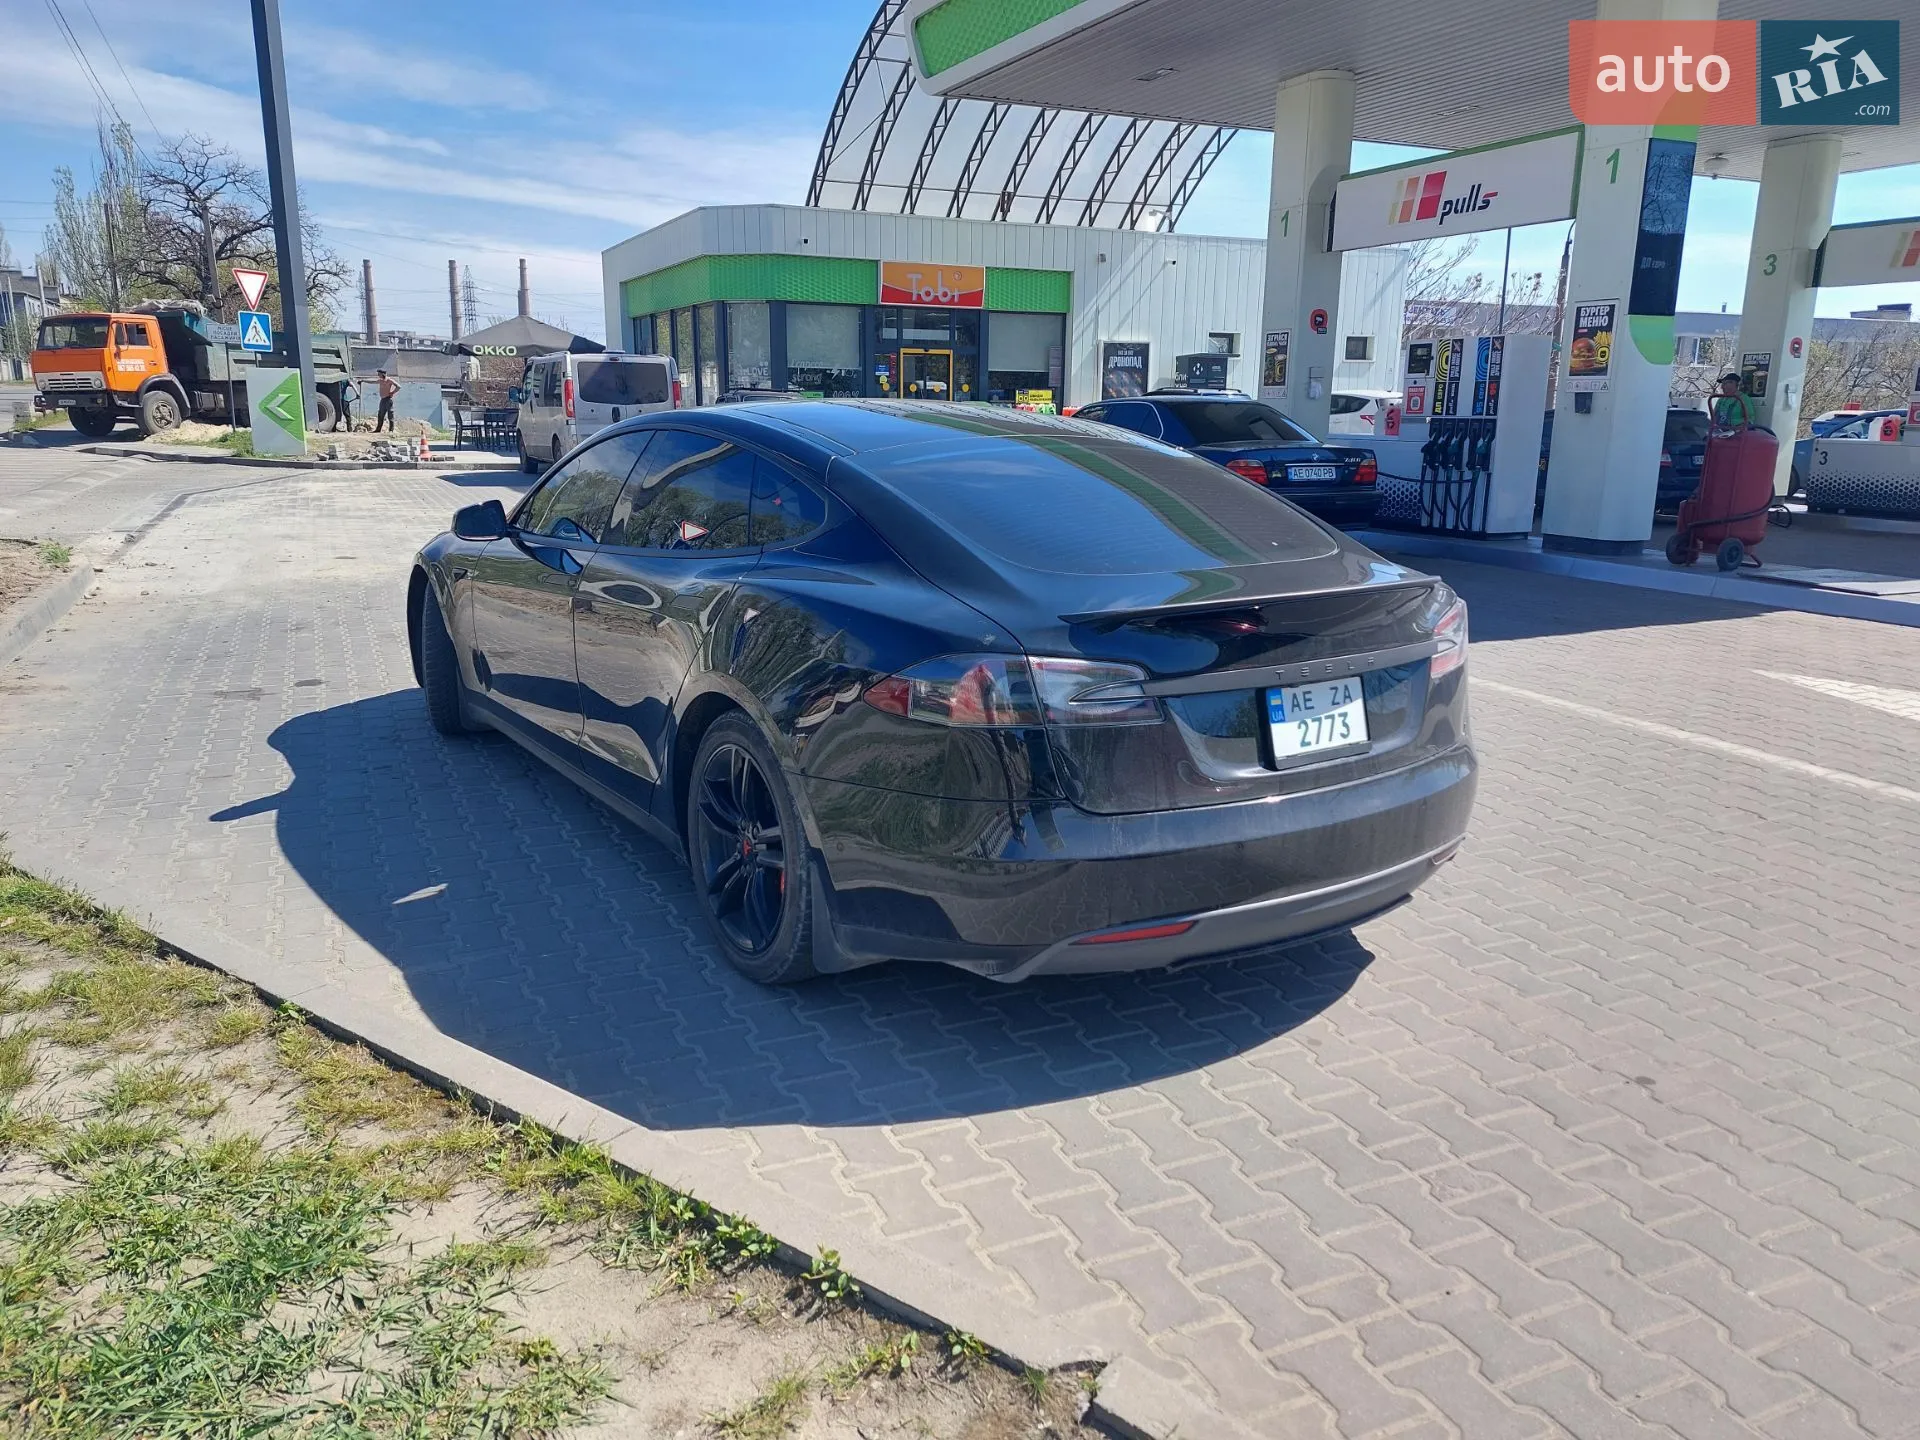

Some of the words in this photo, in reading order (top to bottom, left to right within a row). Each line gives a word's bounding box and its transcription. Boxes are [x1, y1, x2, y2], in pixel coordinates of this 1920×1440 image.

[1606, 148, 1620, 184] 1
[1438, 183, 1498, 226] pulls
[1280, 210, 1290, 238] 1
[1763, 253, 1778, 276] 3
[906, 269, 961, 303] Tobi
[1580, 306, 1610, 317] БУРГЕР
[1579, 316, 1609, 328] МЕНЮ
[473, 345, 517, 356] OKKO
[747, 367, 769, 376] LOVE
[1108, 356, 1143, 369] ДРОНОПАД
[1819, 451, 1829, 465] 3
[1293, 467, 1305, 479] AE
[1305, 467, 1322, 478] 0740
[1323, 466, 1334, 478] PB
[1274, 656, 1376, 680] TESLA
[1291, 690, 1315, 713] AE
[1330, 684, 1353, 707] ZA
[1272, 711, 1285, 722] UA
[1298, 711, 1351, 748] 2773
